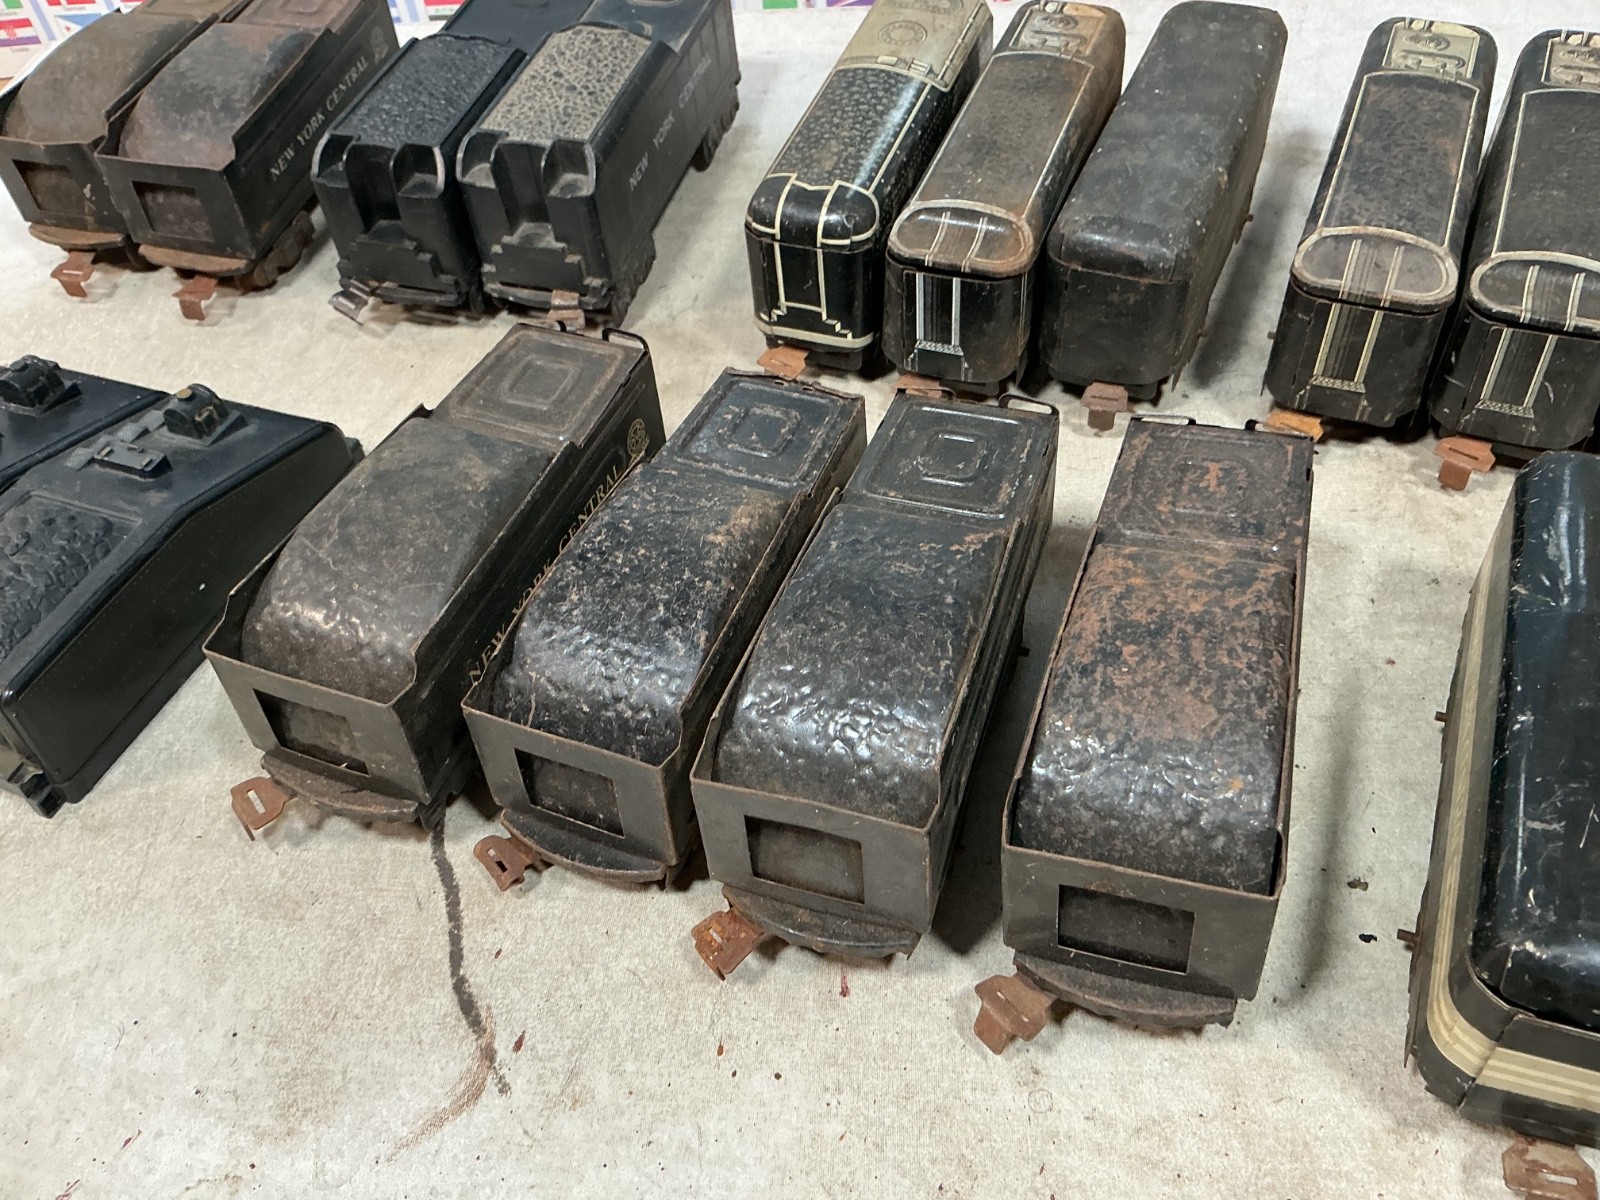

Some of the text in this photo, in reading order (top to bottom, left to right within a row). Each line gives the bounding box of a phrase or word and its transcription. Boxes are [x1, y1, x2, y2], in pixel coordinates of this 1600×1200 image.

[269, 56, 369, 182] NEW YORK CENTRAL
[629, 152, 649, 192] NEW
[559, 464, 622, 554] CENTRAL
